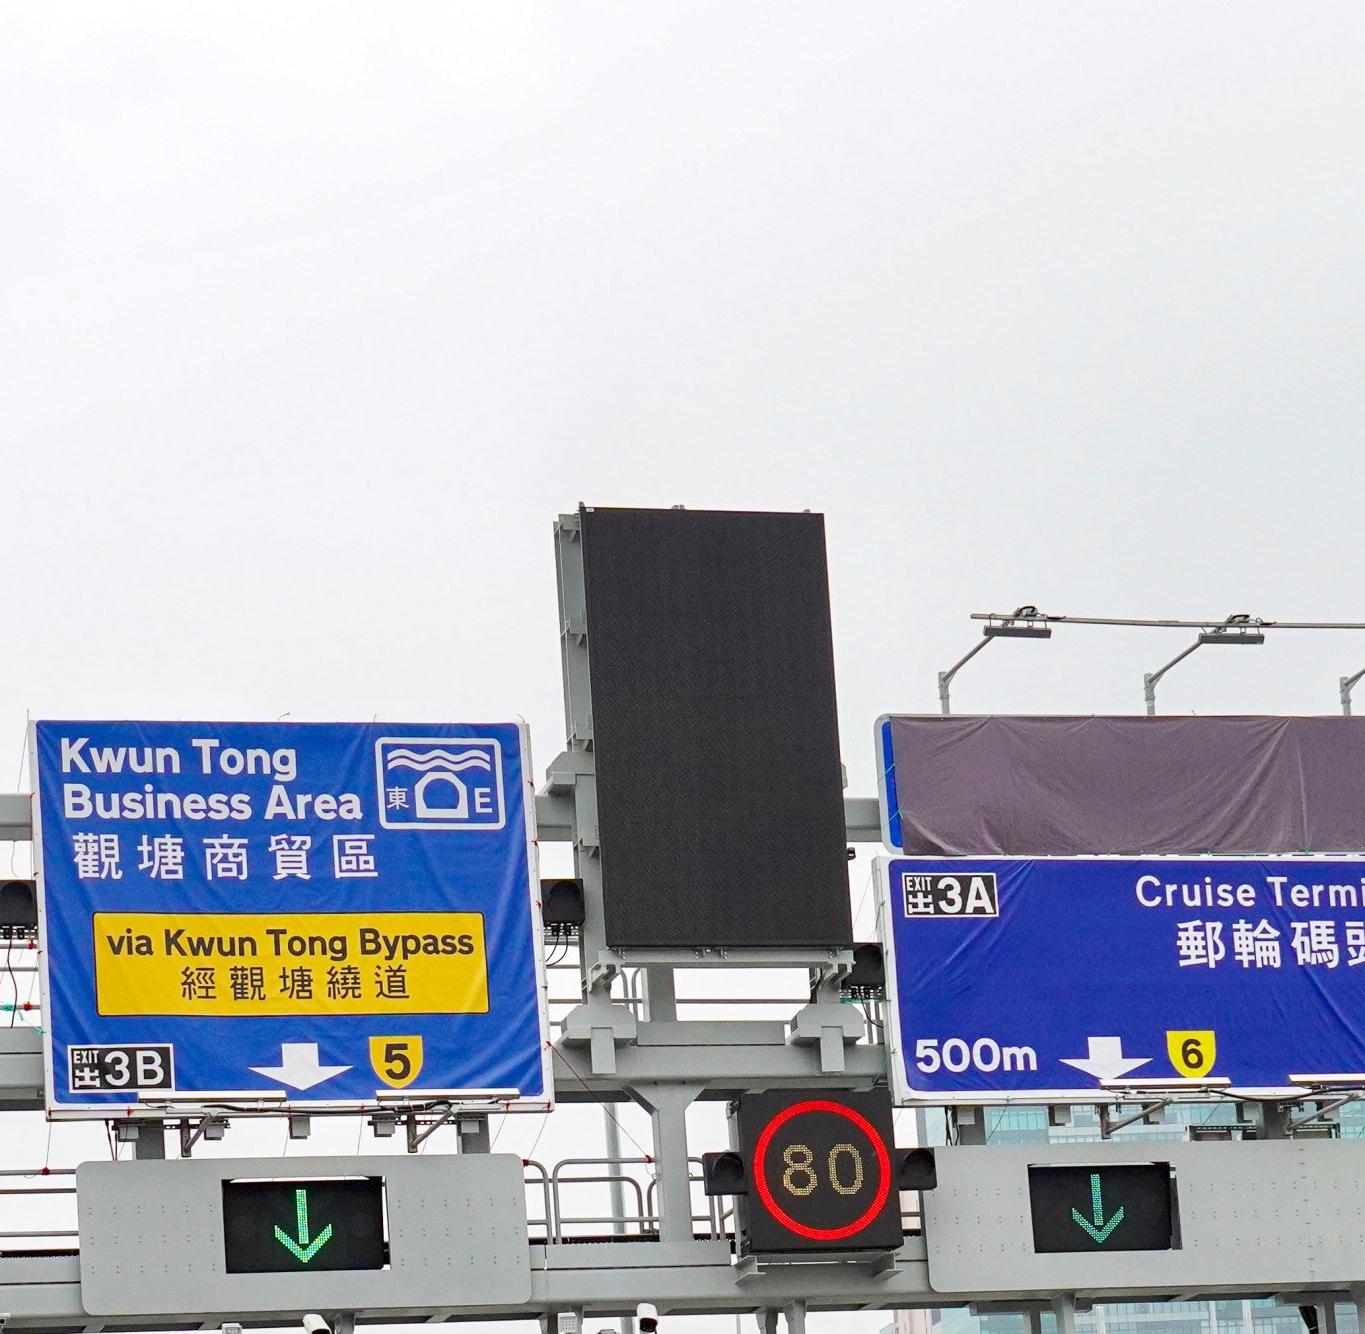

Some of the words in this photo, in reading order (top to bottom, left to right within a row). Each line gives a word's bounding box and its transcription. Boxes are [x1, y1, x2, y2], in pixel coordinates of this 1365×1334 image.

[60, 736, 180, 774] Kwun
[191, 736, 297, 783] Tong
[63, 783, 253, 821] Business
[264, 783, 364, 821] Area
[386, 785, 410, 810] 東
[473, 787, 493, 814] E
[72, 832, 379, 881] 觀塘商貿區
[905, 876, 932, 891] EXIT
[937, 876, 995, 914] 3A
[1135, 875, 1254, 909] Cruise
[907, 892, 934, 914] 出
[106, 927, 154, 957] via
[163, 928, 258, 957] Kwun
[266, 928, 348, 963] Tong
[358, 927, 474, 966] Bypass
[180, 964, 411, 1002] 經觀塘繞道
[73, 1050, 100, 1064] EXIT
[104, 1050, 165, 1086] 3B
[384, 1043, 412, 1081] 5
[915, 1038, 1038, 1074] 500m
[1181, 1038, 1204, 1069] 6
[75, 1067, 101, 1088] 出
[783, 1143, 864, 1196] 80
